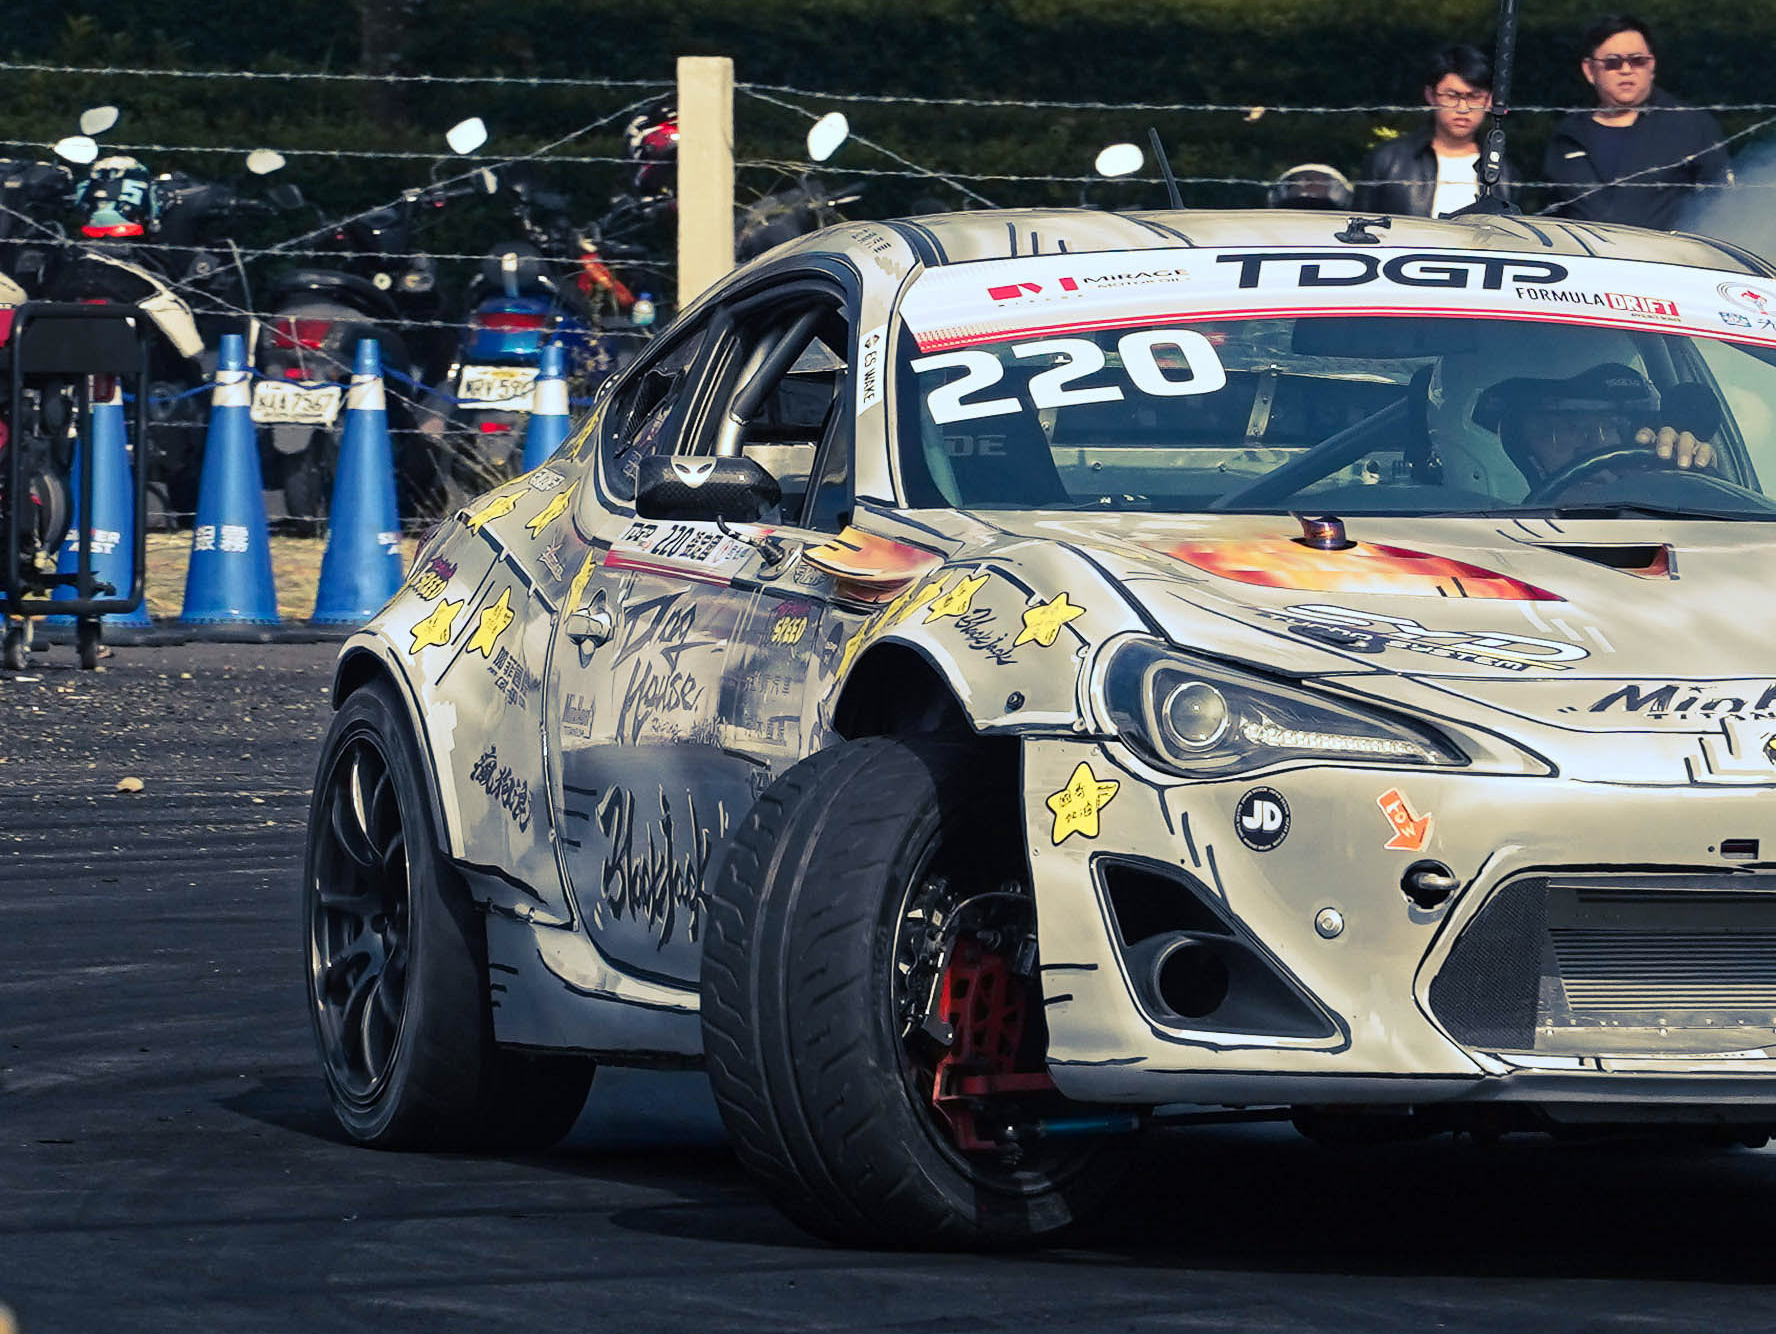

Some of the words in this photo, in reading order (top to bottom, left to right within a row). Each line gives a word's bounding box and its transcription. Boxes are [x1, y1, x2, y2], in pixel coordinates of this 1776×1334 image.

[1215, 252, 1568, 290] TDGP
[1515, 287, 1606, 307] FORMULA
[1607, 294, 1679, 317] DRIFT
[910, 329, 1228, 425] 220
[649, 524, 696, 558] 220
[1384, 639, 1527, 672] SYSTEM
[1241, 799, 1284, 832] JD
[1385, 799, 1417, 839] TOW
